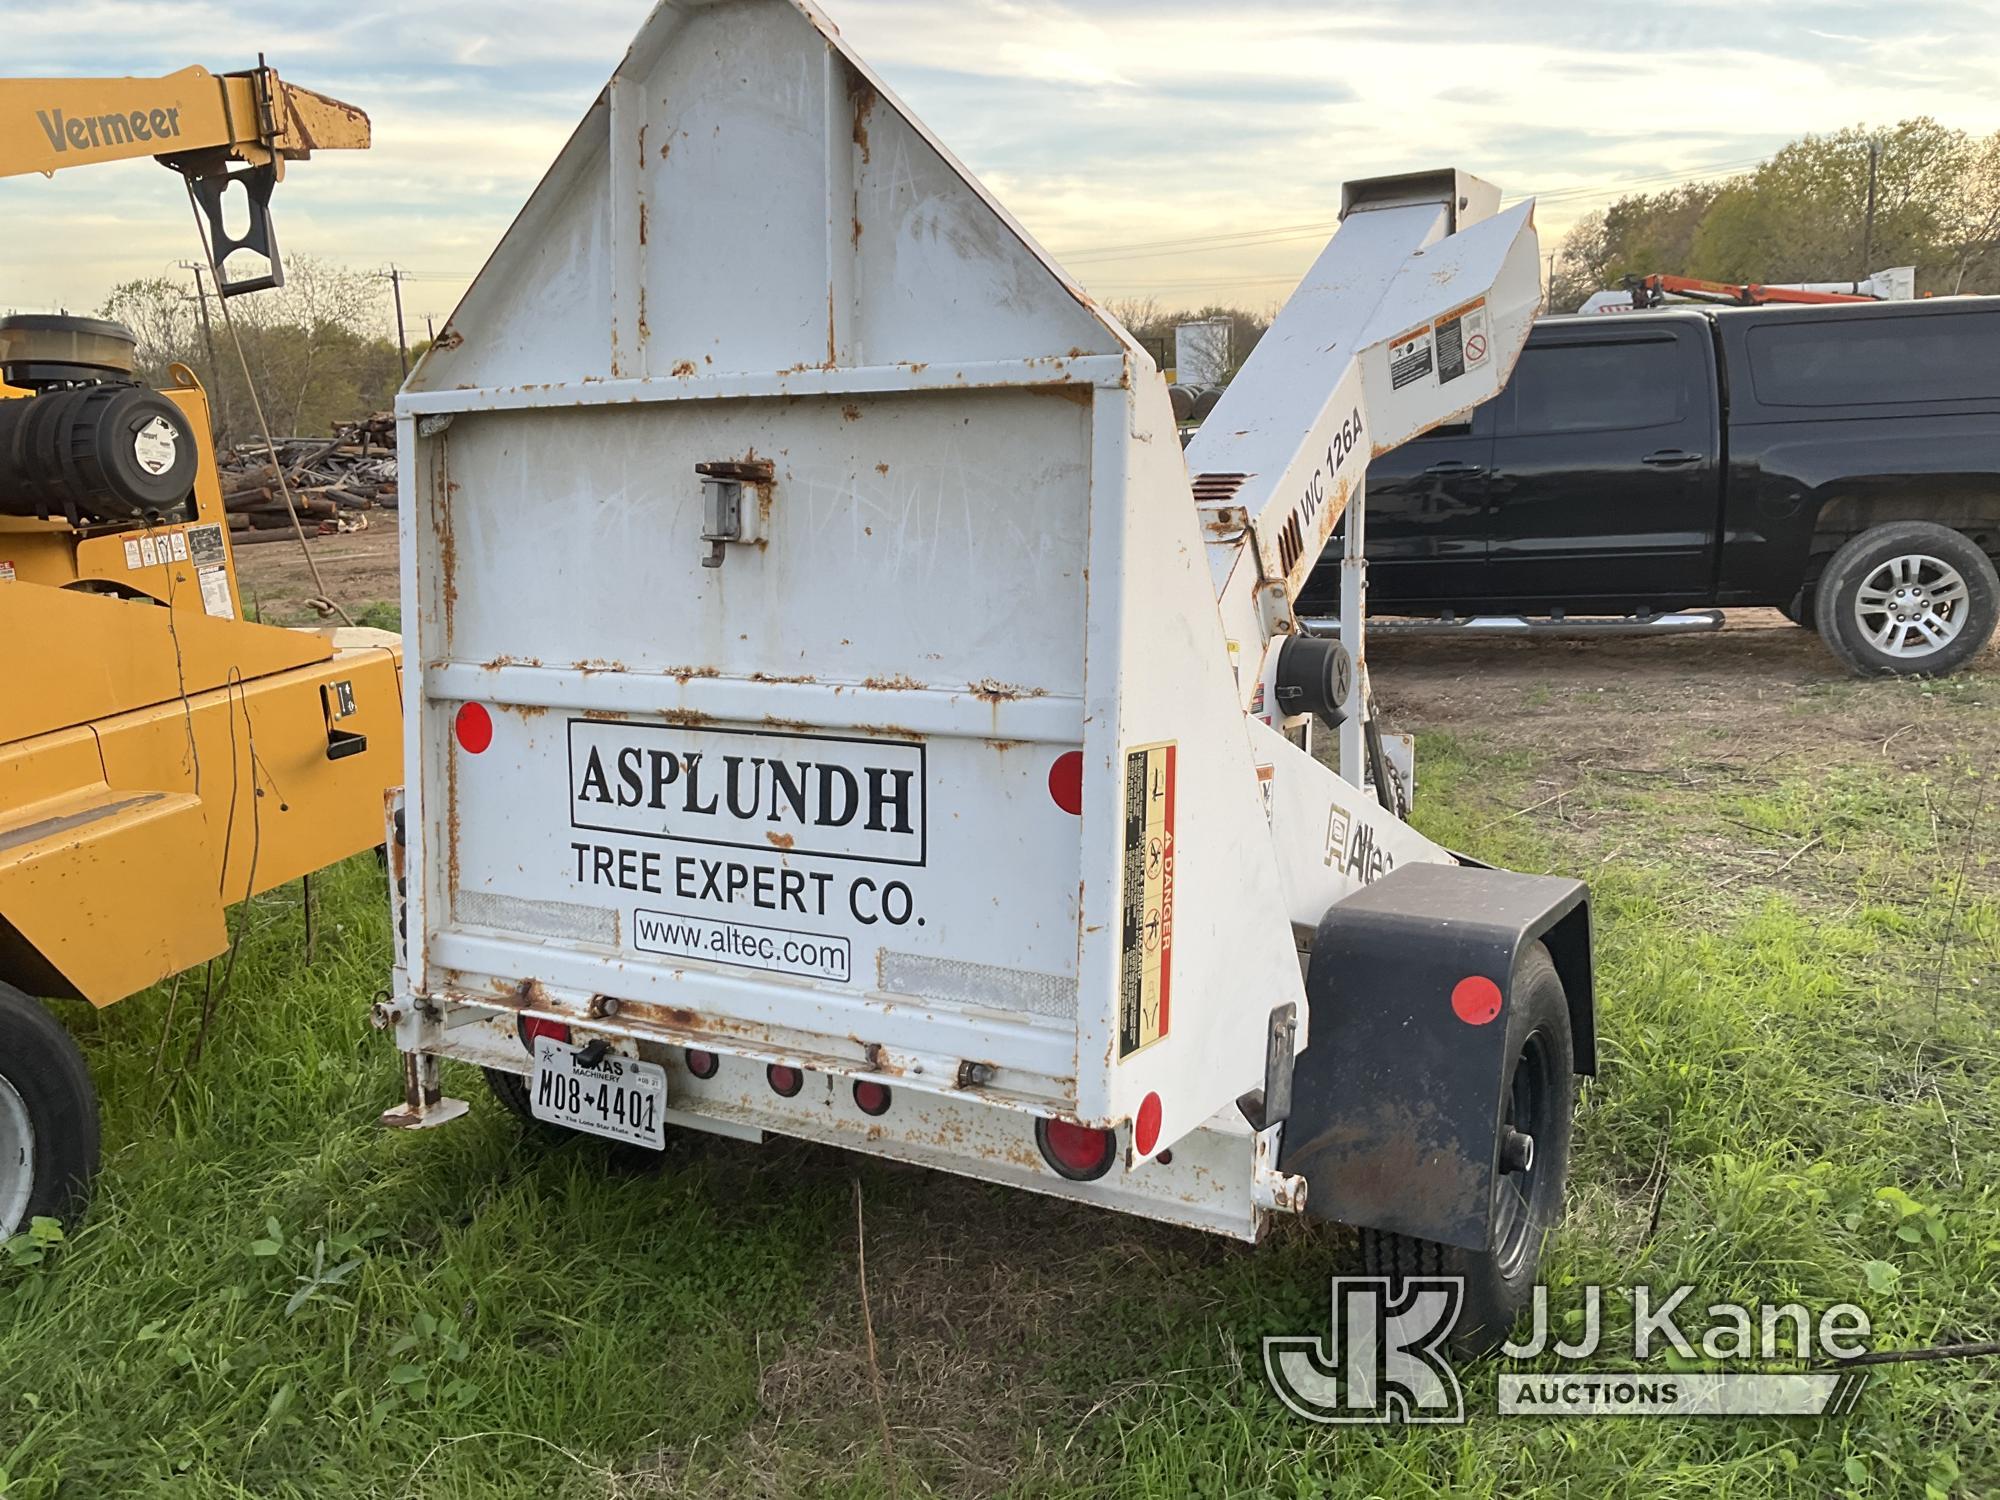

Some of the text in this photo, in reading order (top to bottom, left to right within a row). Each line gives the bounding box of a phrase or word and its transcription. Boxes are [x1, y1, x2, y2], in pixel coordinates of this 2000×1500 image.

[36, 107, 180, 152] Vermeer
[1300, 406, 1363, 527] WC 126A
[578, 744, 914, 834] ASPLUNDH
[571, 842, 926, 926] TREE EXPERT CO.
[1162, 857, 1173, 950] DANGER
[640, 919, 845, 970] www.altec.com
[573, 1067, 621, 1083] MACHINERY
